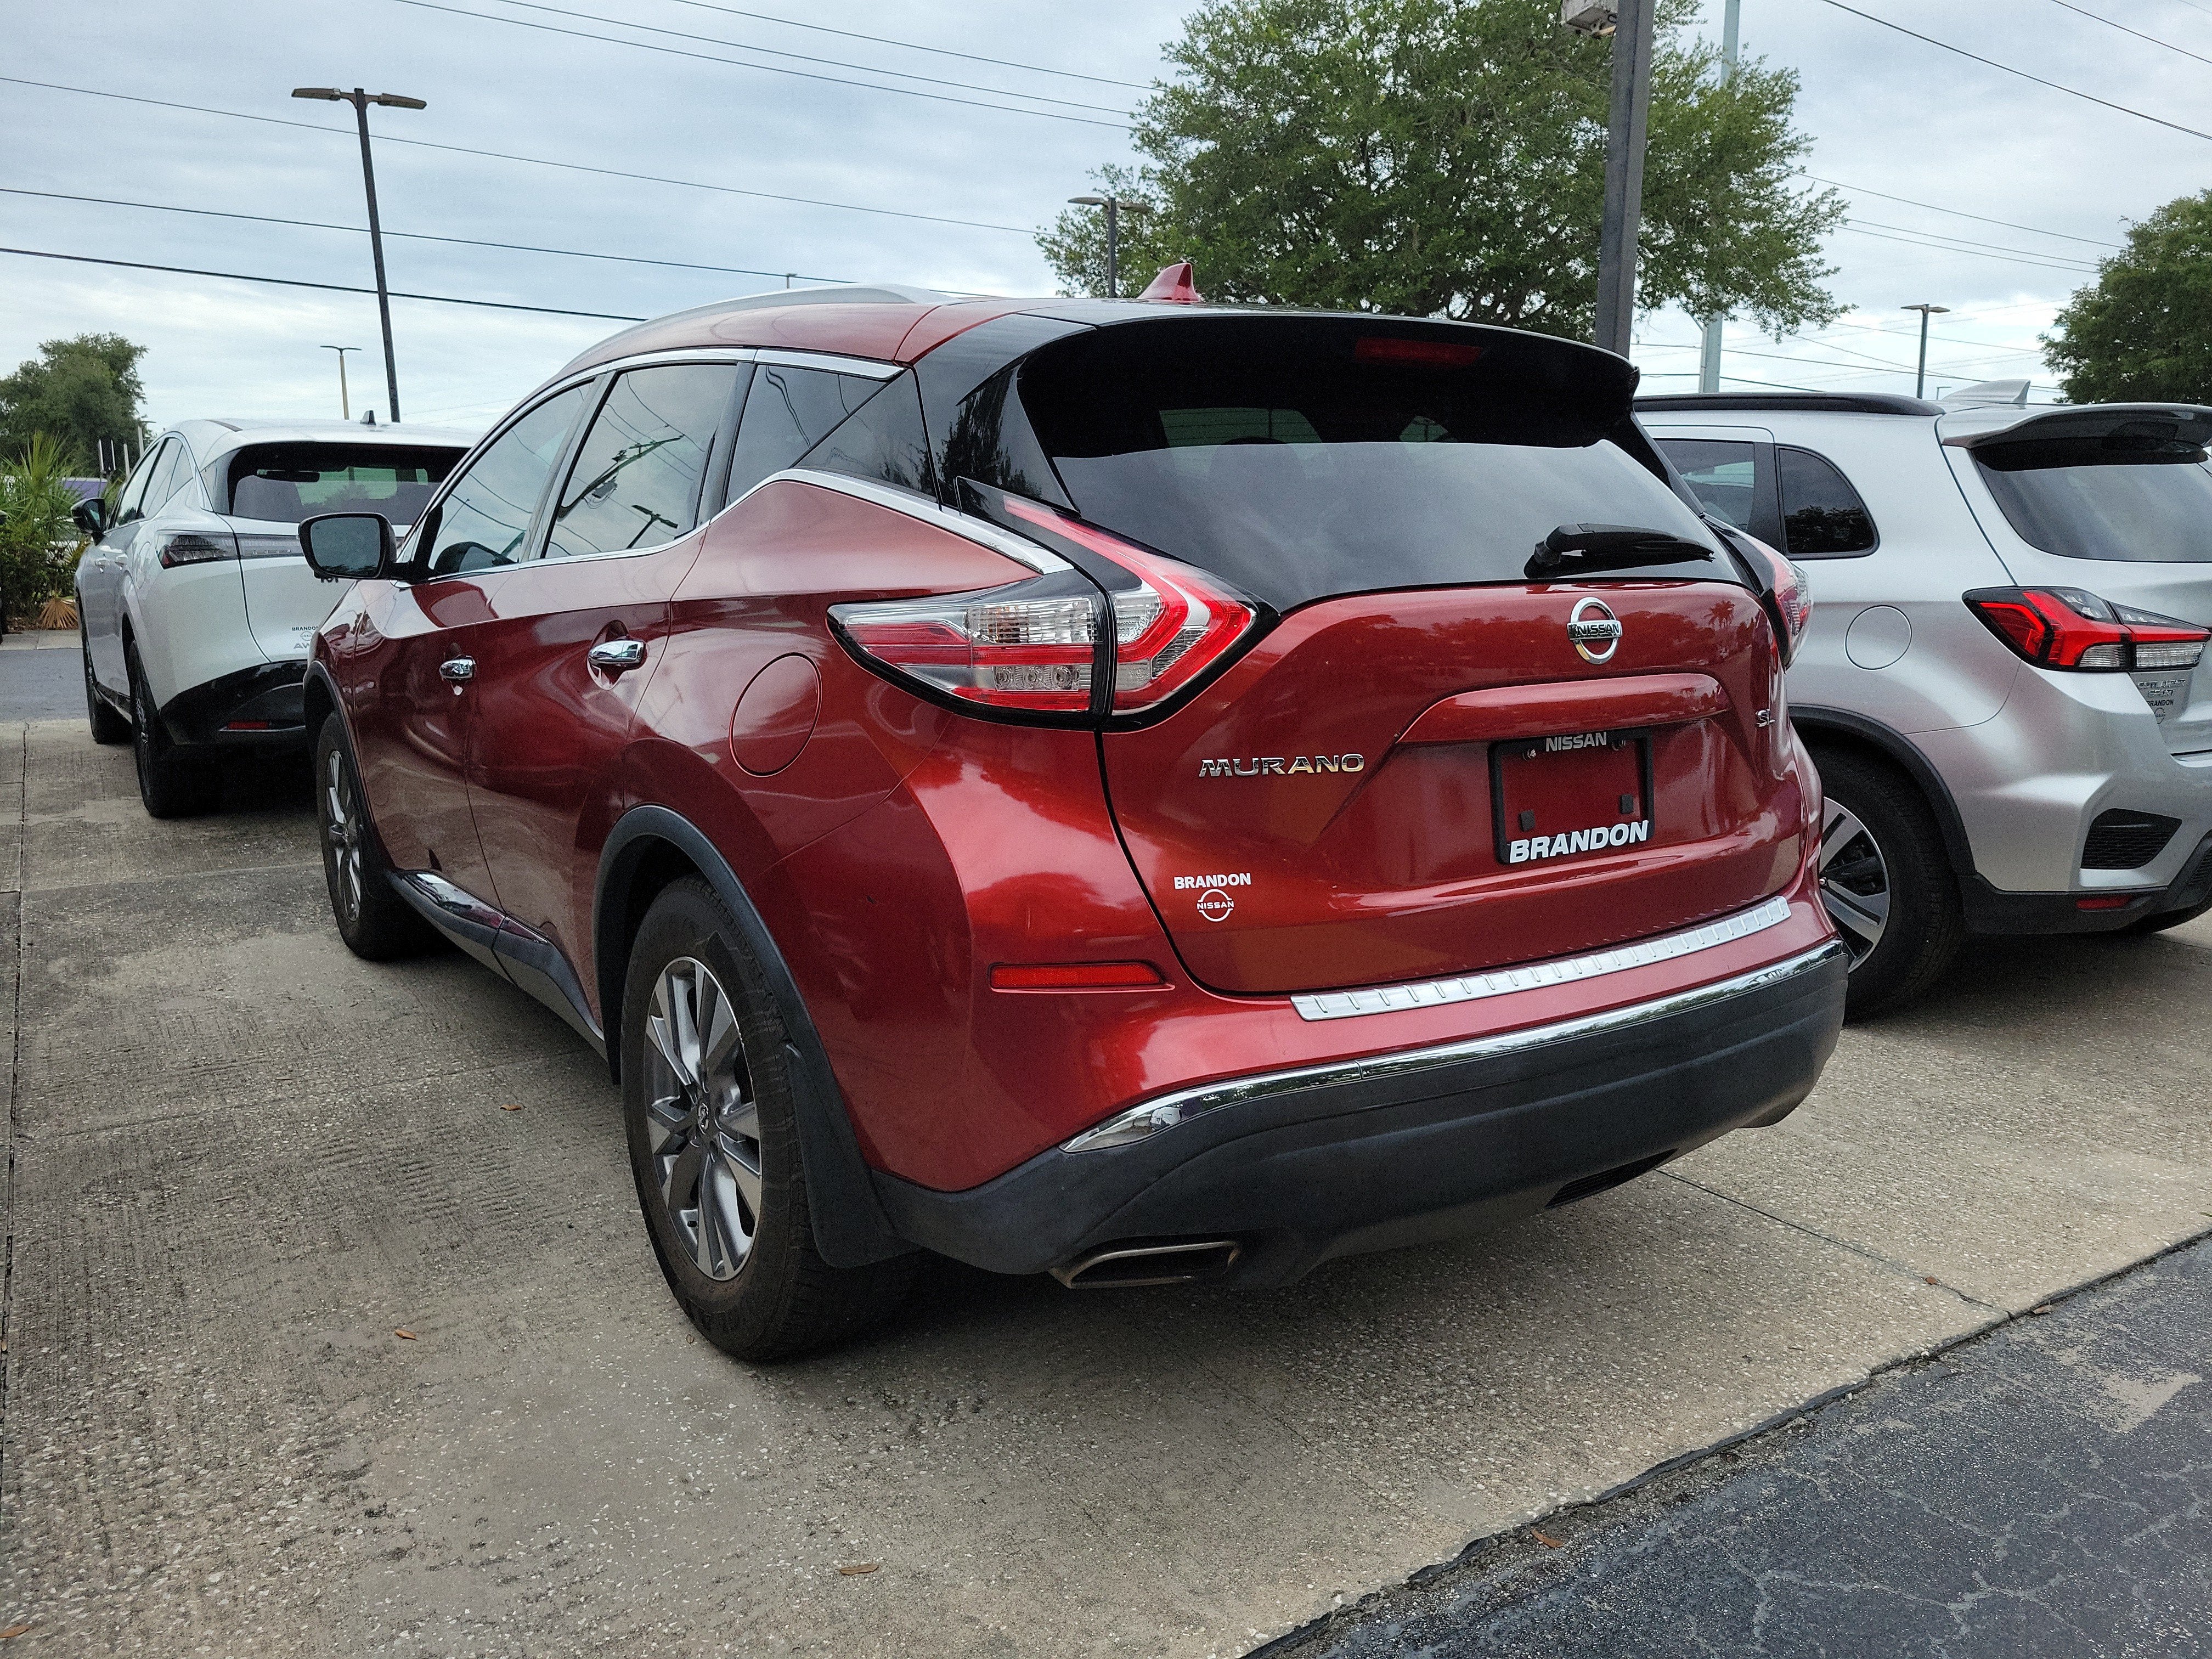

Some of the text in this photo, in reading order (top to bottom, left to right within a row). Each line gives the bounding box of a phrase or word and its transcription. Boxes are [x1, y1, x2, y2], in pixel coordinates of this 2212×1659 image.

[1577, 624, 1620, 635] NISSAN
[1755, 709, 1775, 727] SL
[1545, 732, 1607, 752] NISSAN
[1199, 753, 1364, 777] MURANO
[1510, 820, 1649, 864] BRANDON
[1174, 872, 1251, 889] BRANDON
[1197, 901, 1234, 910] NISSAN
